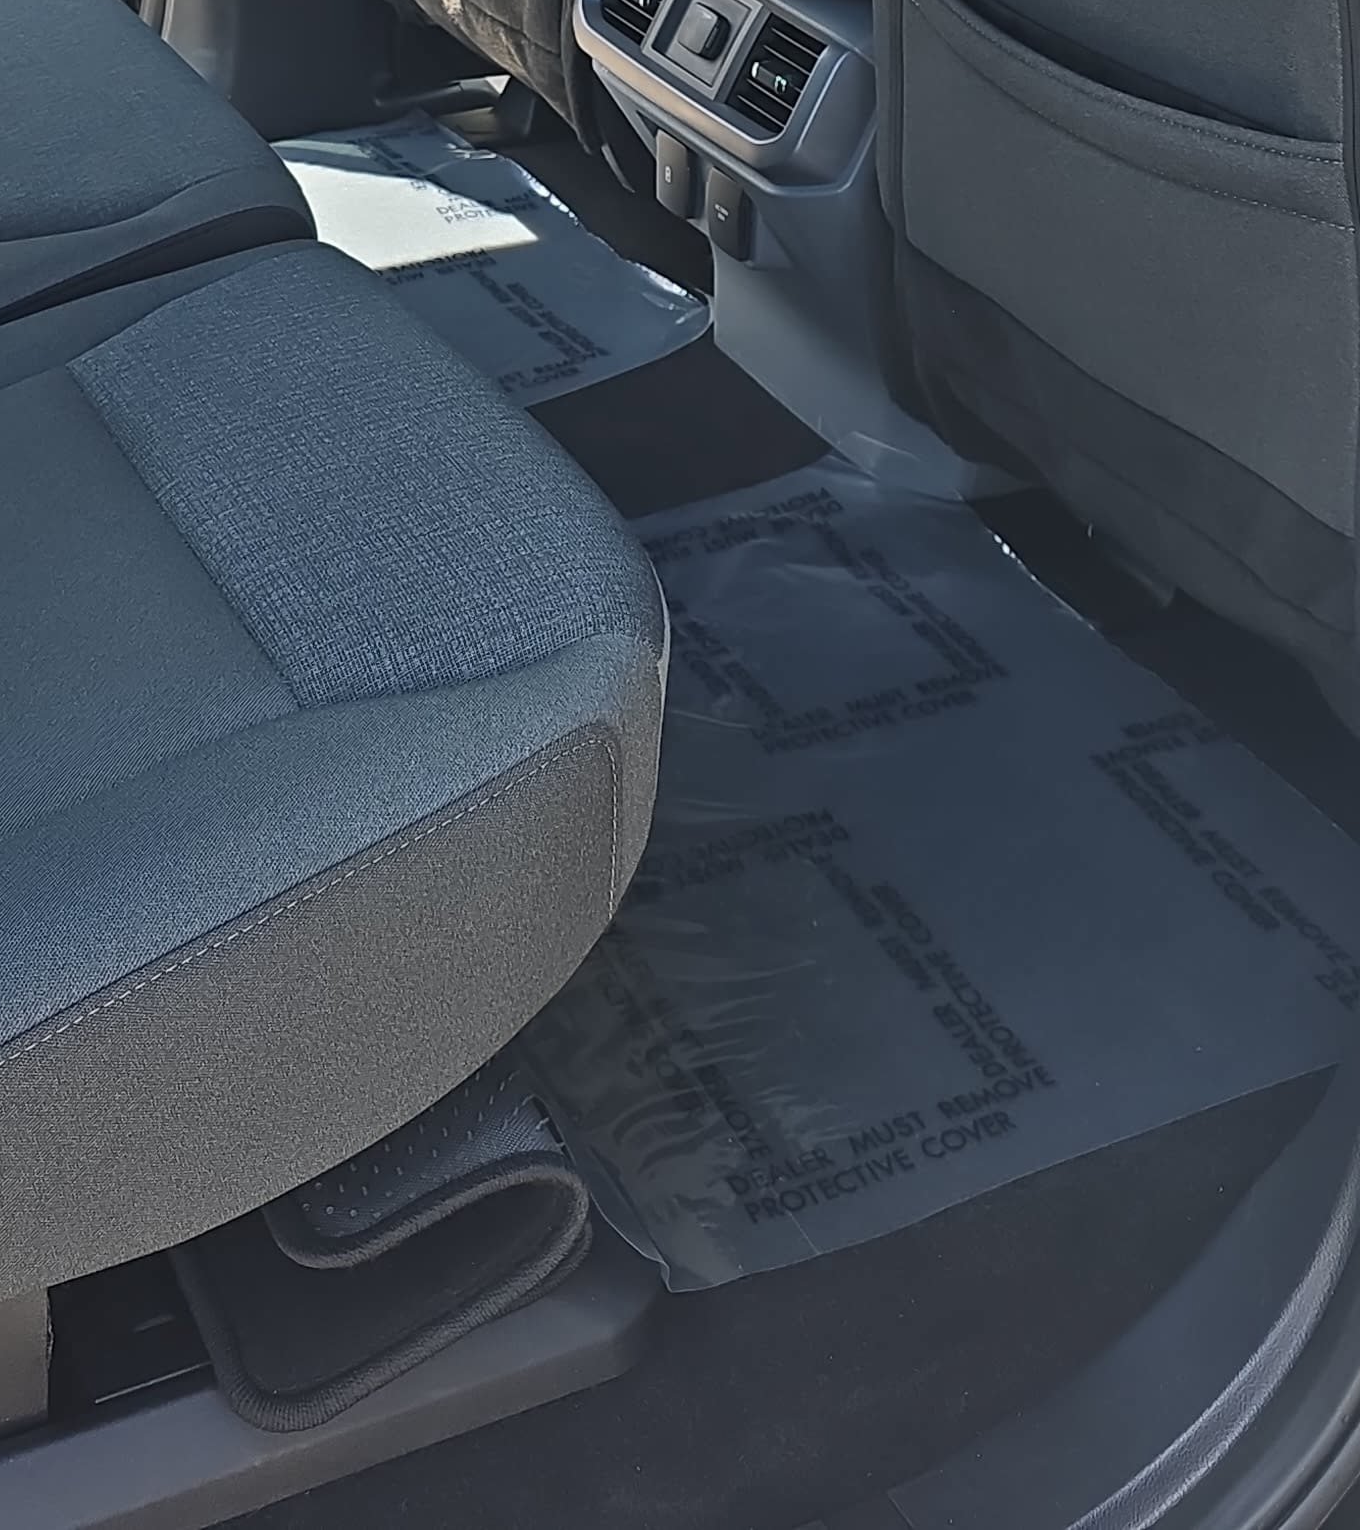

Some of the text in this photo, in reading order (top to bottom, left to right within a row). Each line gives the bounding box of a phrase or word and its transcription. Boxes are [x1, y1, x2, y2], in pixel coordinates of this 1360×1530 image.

[723, 1064, 1058, 1198] DEALER MUST REMOVE
[743, 1109, 1018, 1225] PROTECTIVE COVER
